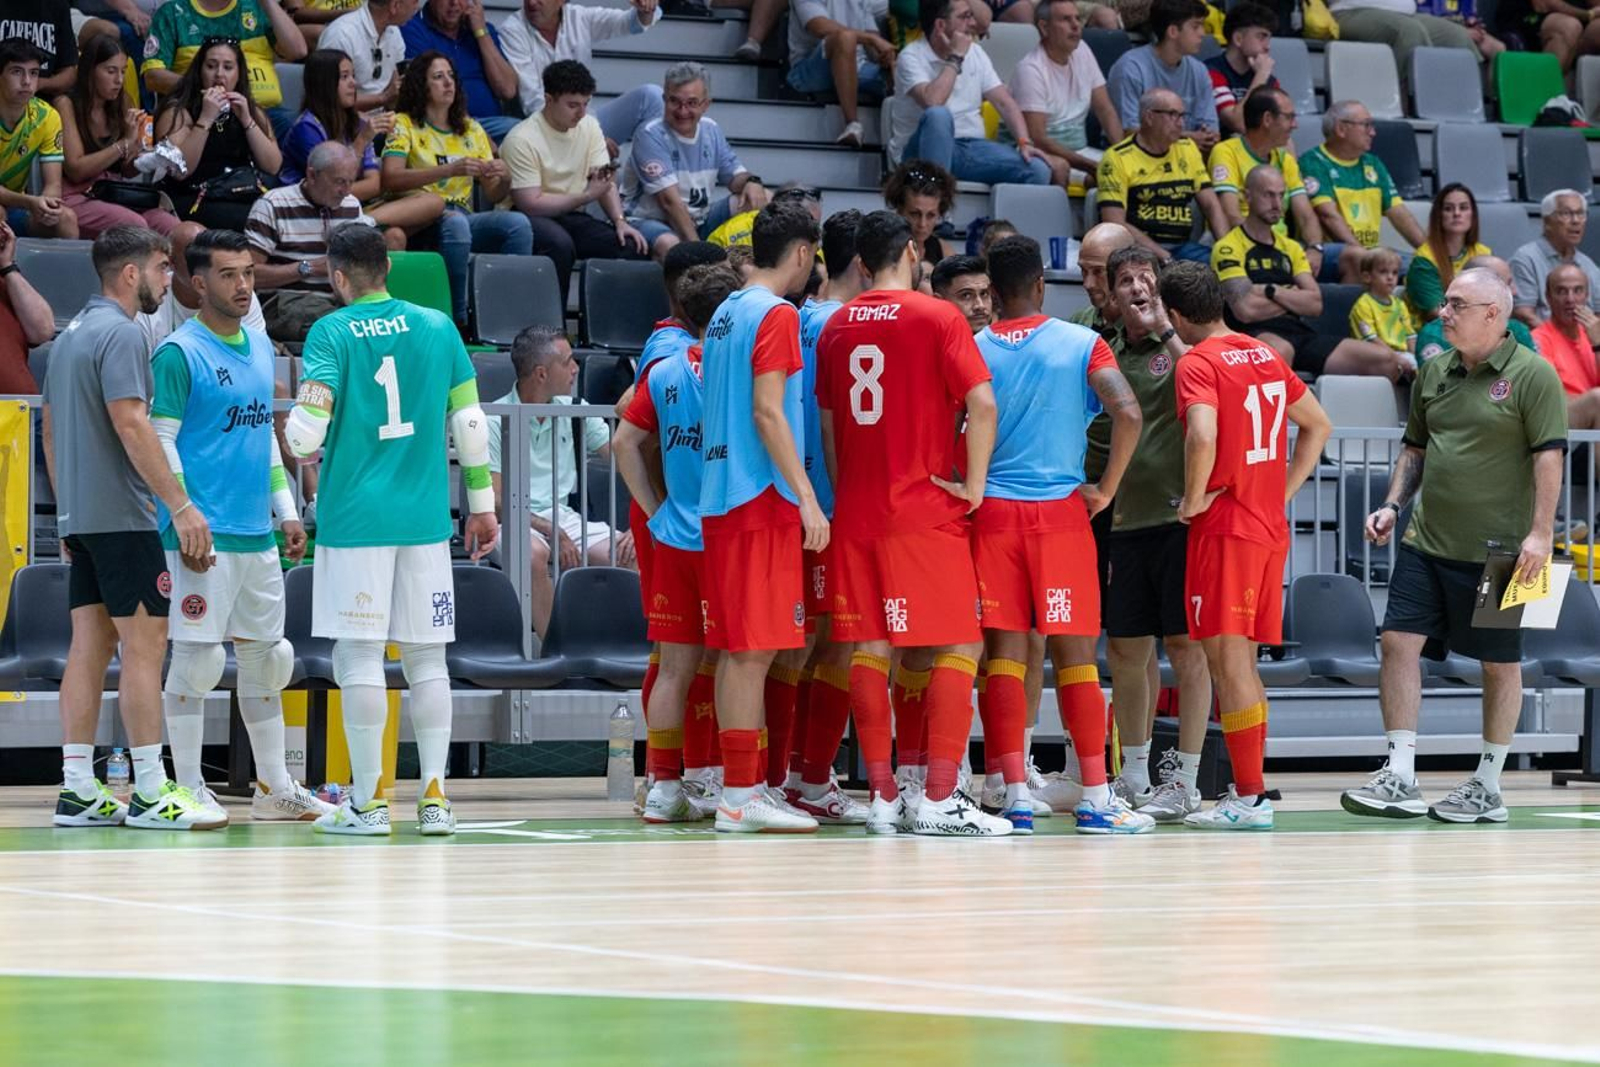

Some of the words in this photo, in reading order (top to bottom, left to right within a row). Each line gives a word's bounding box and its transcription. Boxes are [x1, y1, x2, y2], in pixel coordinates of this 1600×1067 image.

[350, 315, 410, 338] CHEMI
[848, 304, 901, 322] TOMAZ
[374, 356, 415, 440] 1
[849, 344, 885, 425] 8
[1243, 380, 1287, 465] 17
[1191, 595, 1202, 627] 7
